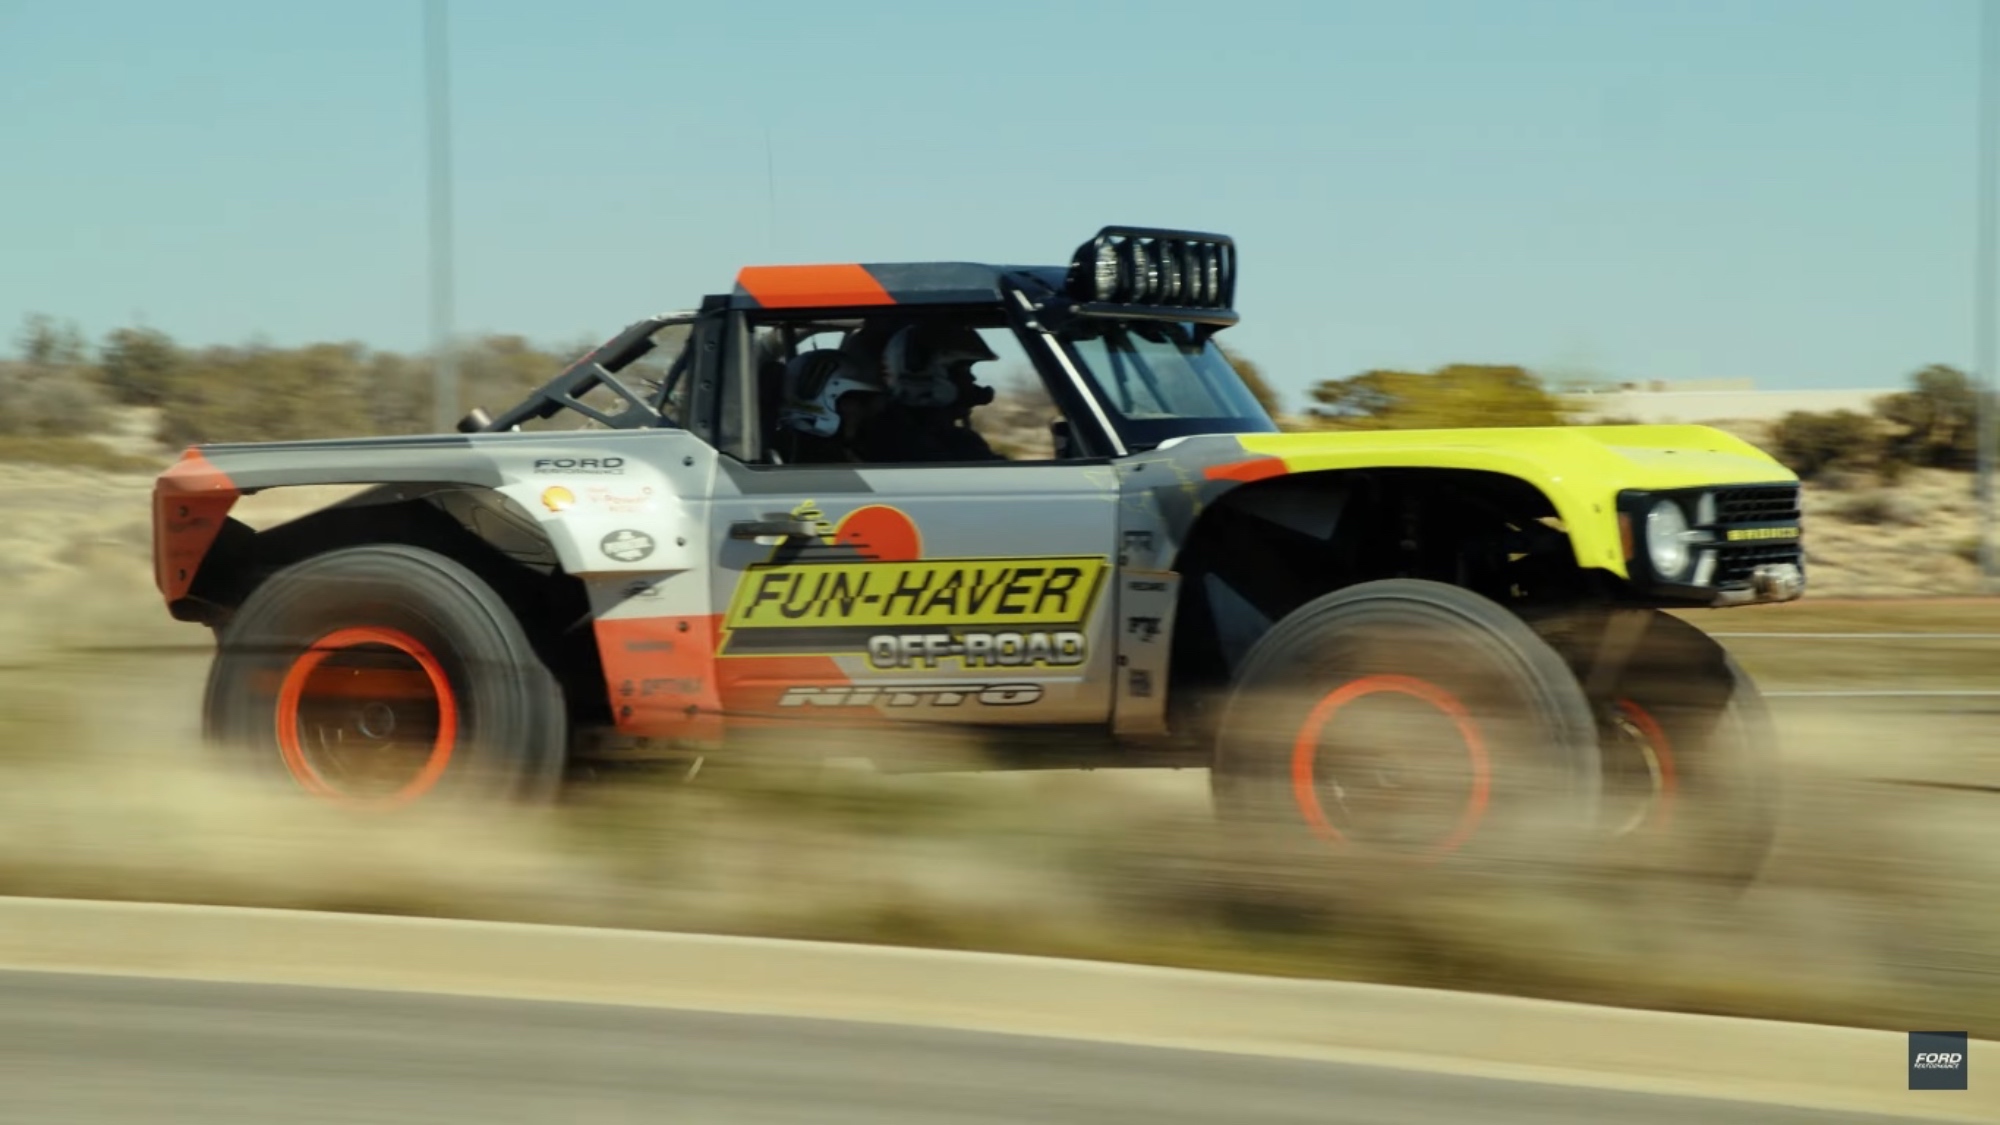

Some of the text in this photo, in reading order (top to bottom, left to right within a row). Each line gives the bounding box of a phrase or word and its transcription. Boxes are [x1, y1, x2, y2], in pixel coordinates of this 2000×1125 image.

[534, 457, 624, 468] FORD
[743, 567, 1083, 618] FUN-HAVER
[868, 632, 1085, 668] OFF-ROAD
[778, 683, 1044, 707] NITTO
